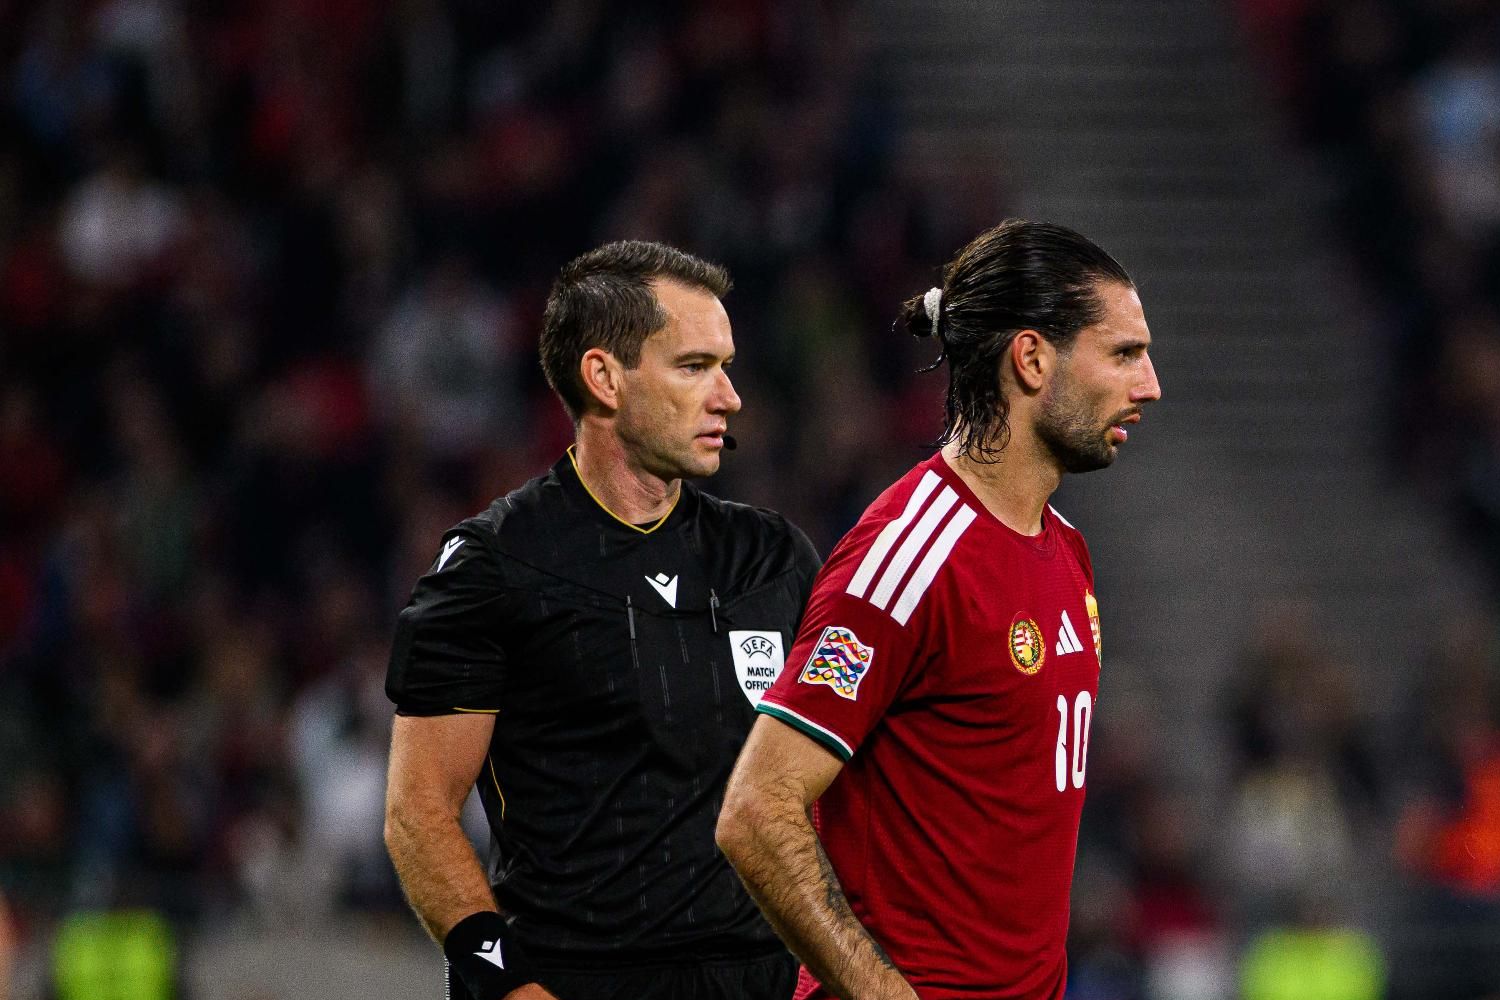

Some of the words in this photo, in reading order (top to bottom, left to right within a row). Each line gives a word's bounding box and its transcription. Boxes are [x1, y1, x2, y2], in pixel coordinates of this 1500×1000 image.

[743, 639, 773, 657] UEFA
[747, 666, 775, 678] MATCH
[1055, 690, 1092, 793] 10
